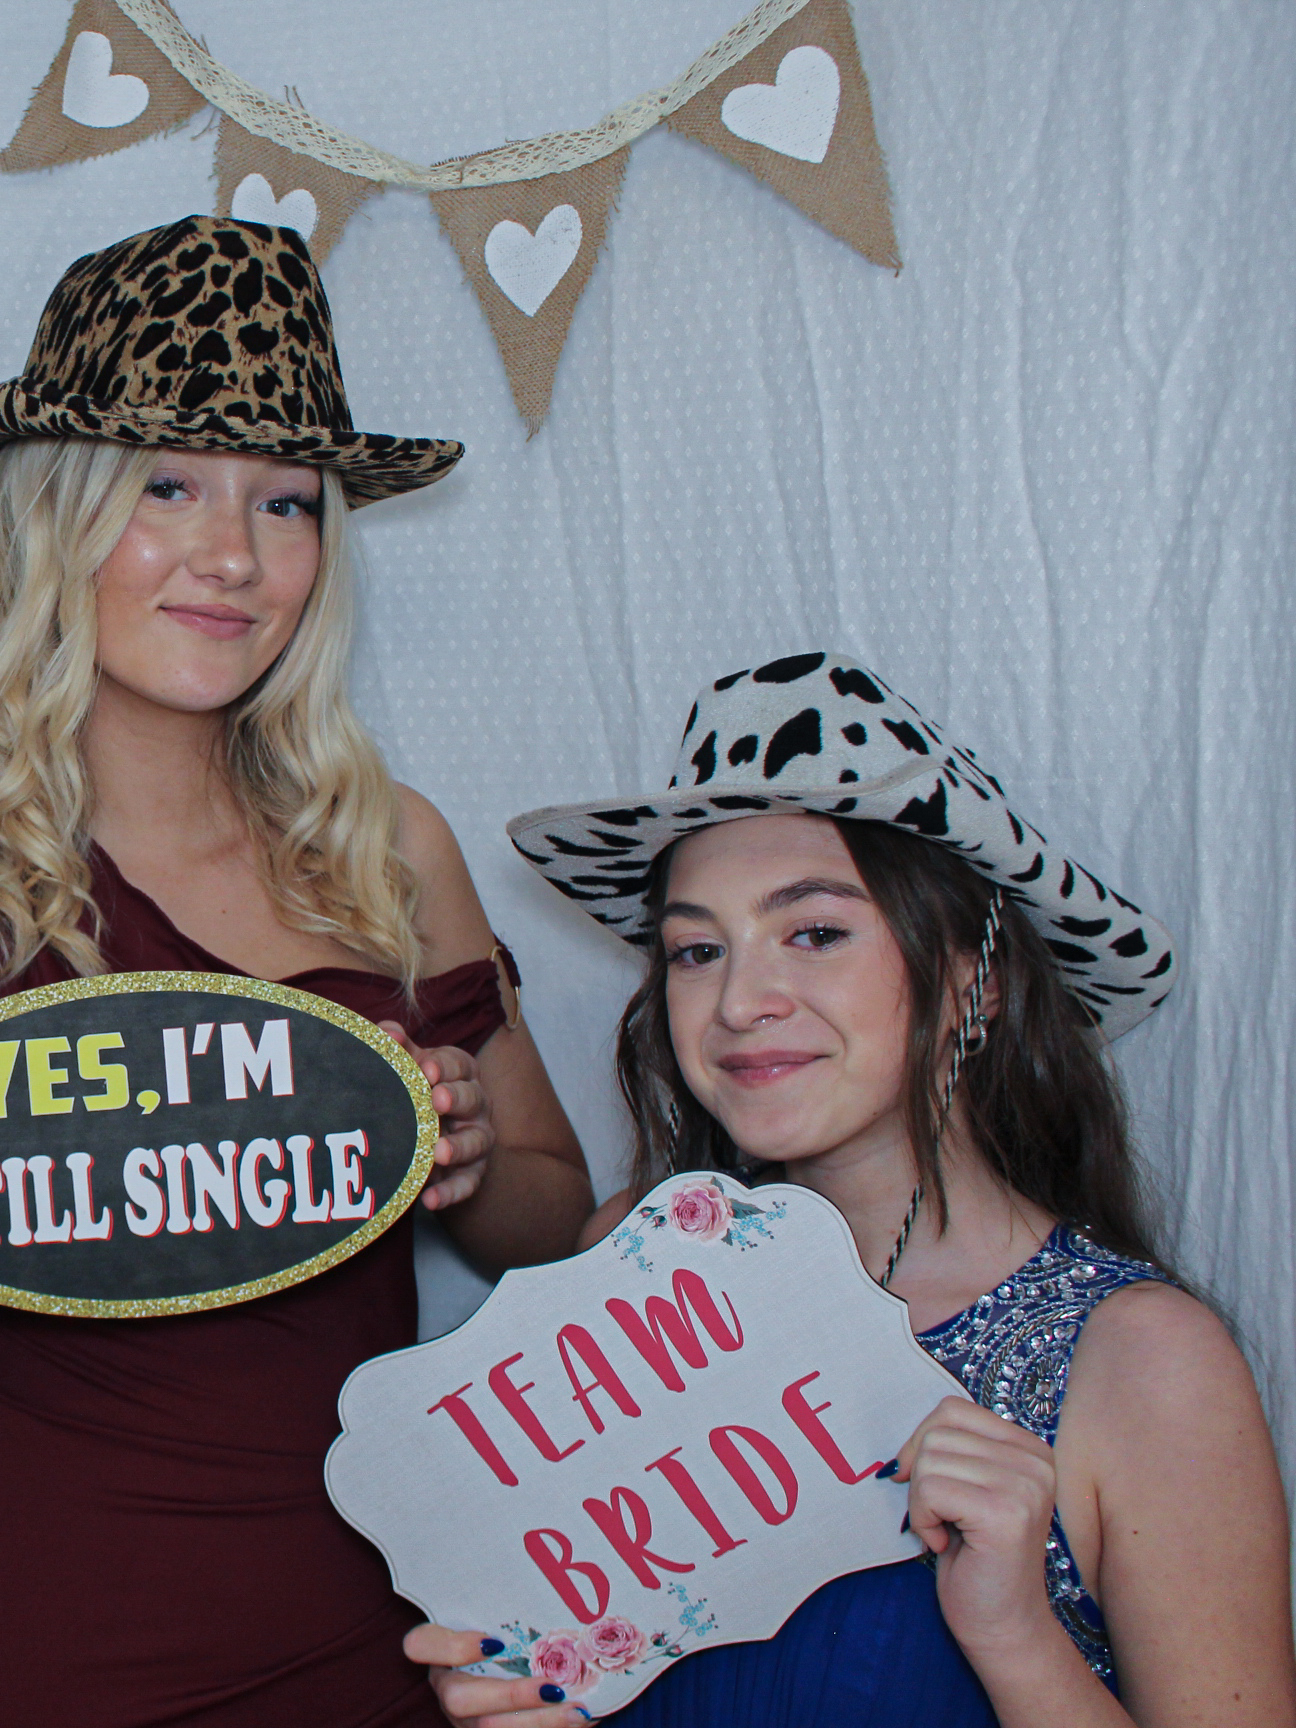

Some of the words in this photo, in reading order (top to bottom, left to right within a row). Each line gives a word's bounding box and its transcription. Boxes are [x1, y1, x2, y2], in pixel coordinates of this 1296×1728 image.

[162, 1018, 295, 1105] I'M
[123, 1129, 374, 1238] SINGLE
[427, 1268, 744, 1487] TEAM
[523, 1370, 885, 1625] BRIDE
